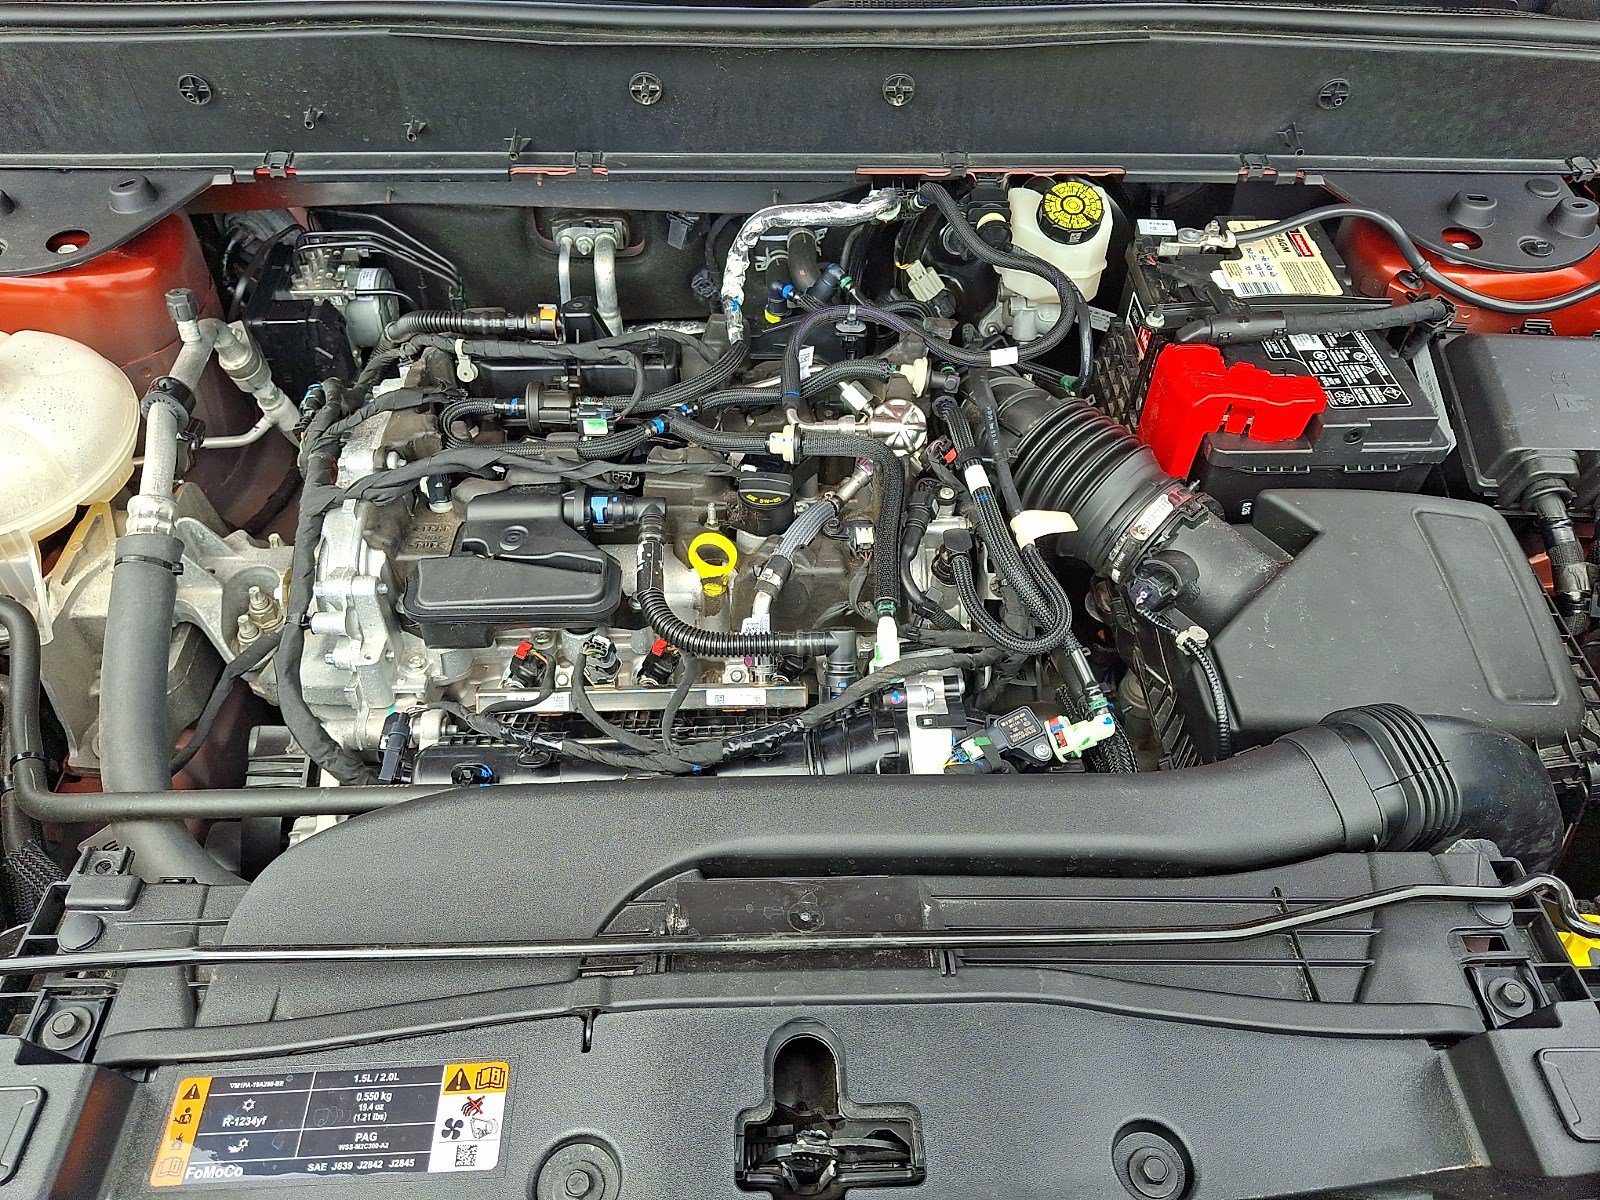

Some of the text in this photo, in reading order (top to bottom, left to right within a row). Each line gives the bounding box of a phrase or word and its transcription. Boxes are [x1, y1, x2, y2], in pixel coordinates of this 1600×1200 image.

[353, 1074, 373, 1083] 1.5L
[380, 1073, 400, 1082] 2.0L
[356, 1091, 393, 1102] 0.550 kg
[358, 1103, 373, 1111] 19.4
[222, 1115, 268, 1128] R-1234yf
[353, 1112, 388, 1123] (1.21 lbs)
[354, 1132, 378, 1142] PAG
[307, 1159, 415, 1172] SAE J639 J2842 J2845
[184, 1164, 244, 1180] FoMoCo
